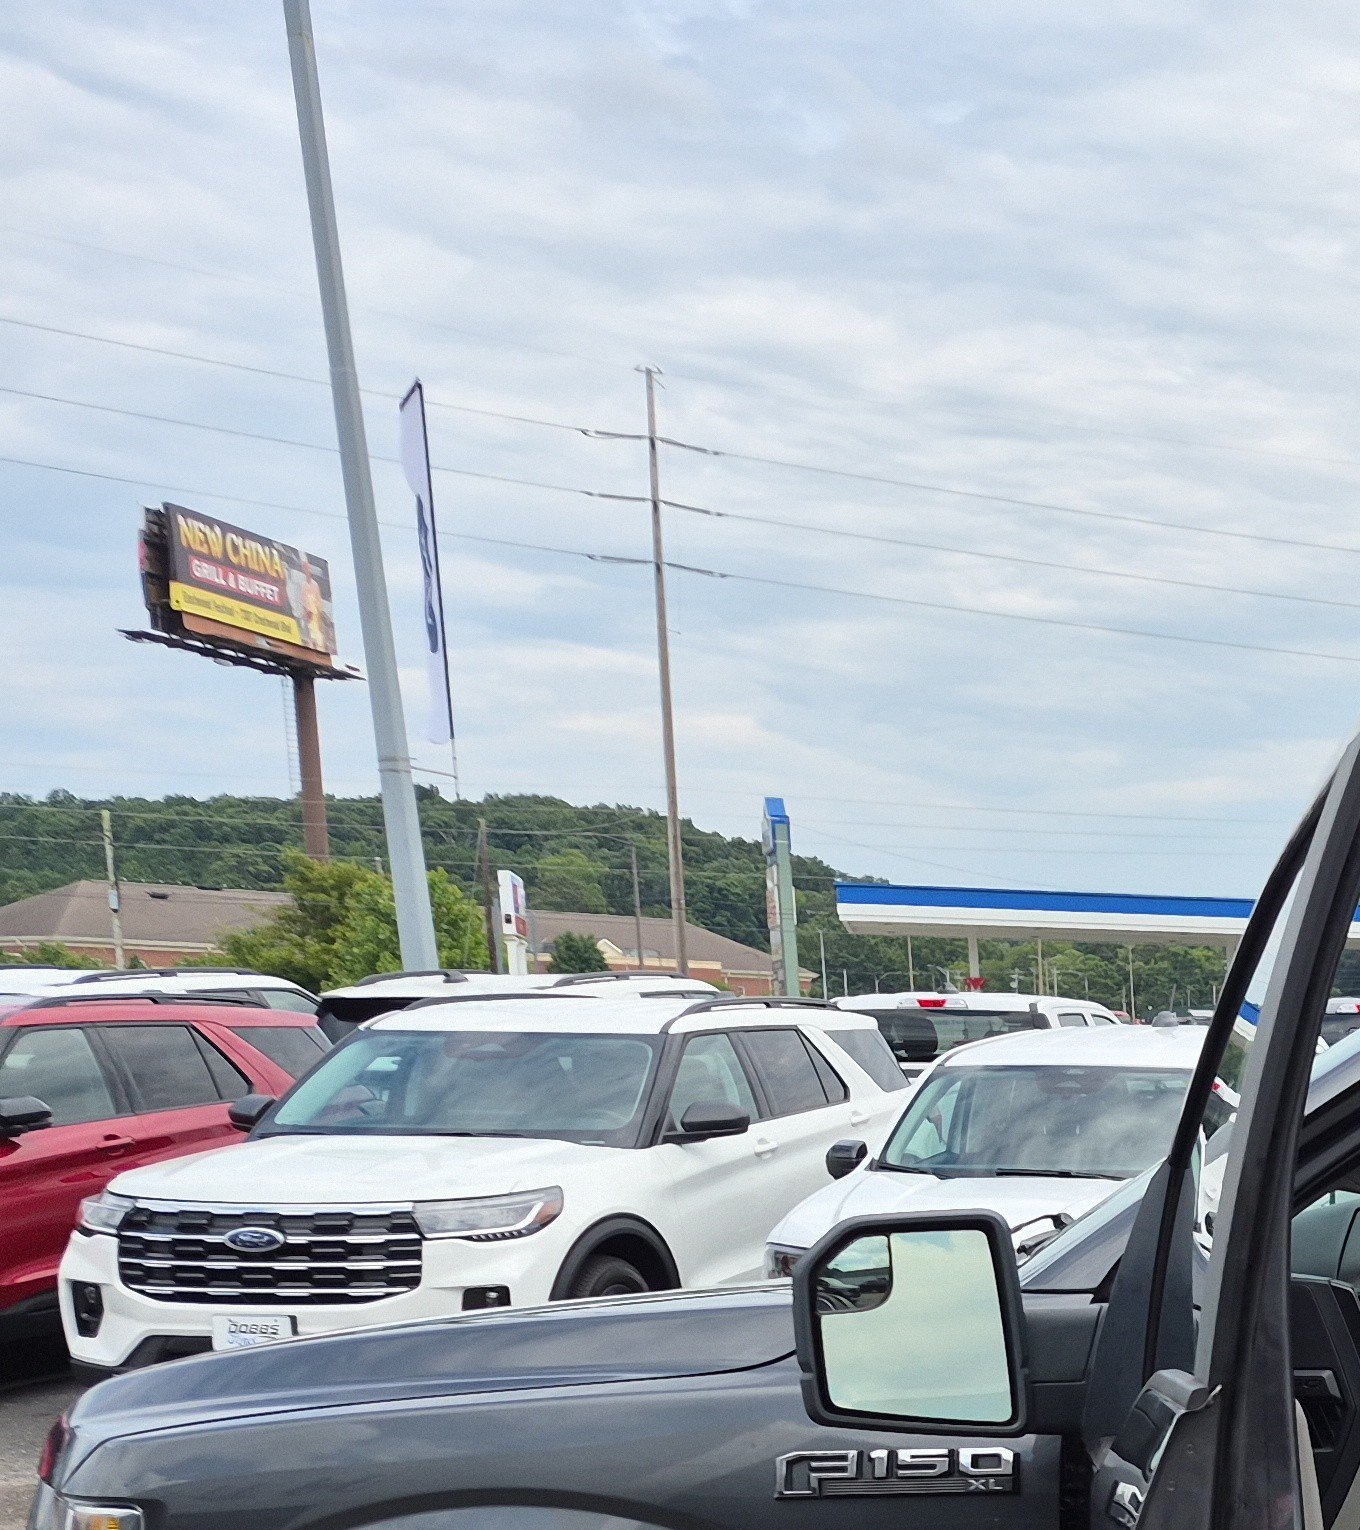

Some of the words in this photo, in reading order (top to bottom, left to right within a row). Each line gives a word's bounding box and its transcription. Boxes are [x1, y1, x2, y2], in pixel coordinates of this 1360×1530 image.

[177, 514, 223, 559] NEW
[225, 532, 286, 580] CHINA
[191, 558, 227, 586] GRILL
[237, 573, 280, 604] BUFFET
[228, 1323, 280, 1336] DOBBS
[967, 1478, 1004, 1491] XL
